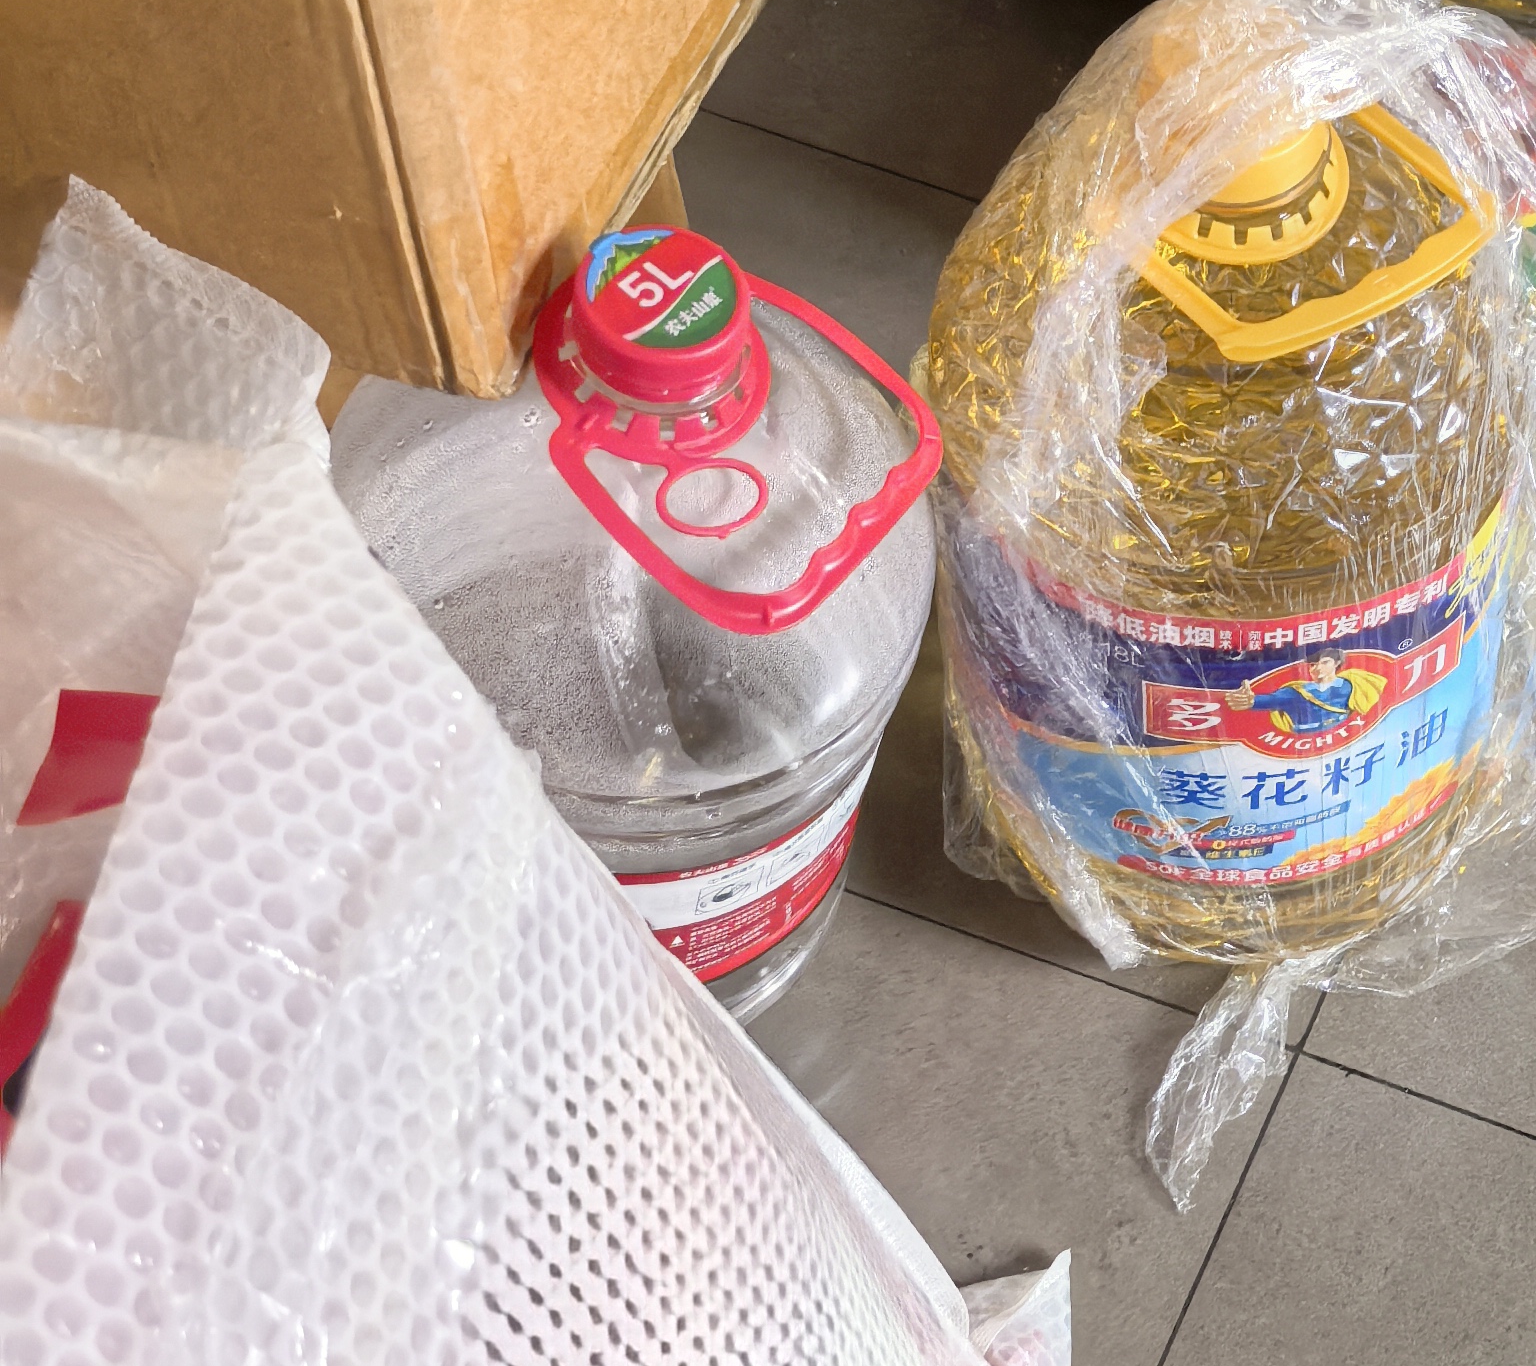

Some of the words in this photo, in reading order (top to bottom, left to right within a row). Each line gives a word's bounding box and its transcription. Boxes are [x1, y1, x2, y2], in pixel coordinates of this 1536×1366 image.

[616, 260, 695, 308] 5L
[1263, 573, 1449, 649] 中国发明专利
[1166, 698, 1222, 731] 多
[1401, 643, 1447, 694] 力
[1160, 706, 1449, 810] 葵花籽油
[1258, 715, 1367, 750] MIGHTY
